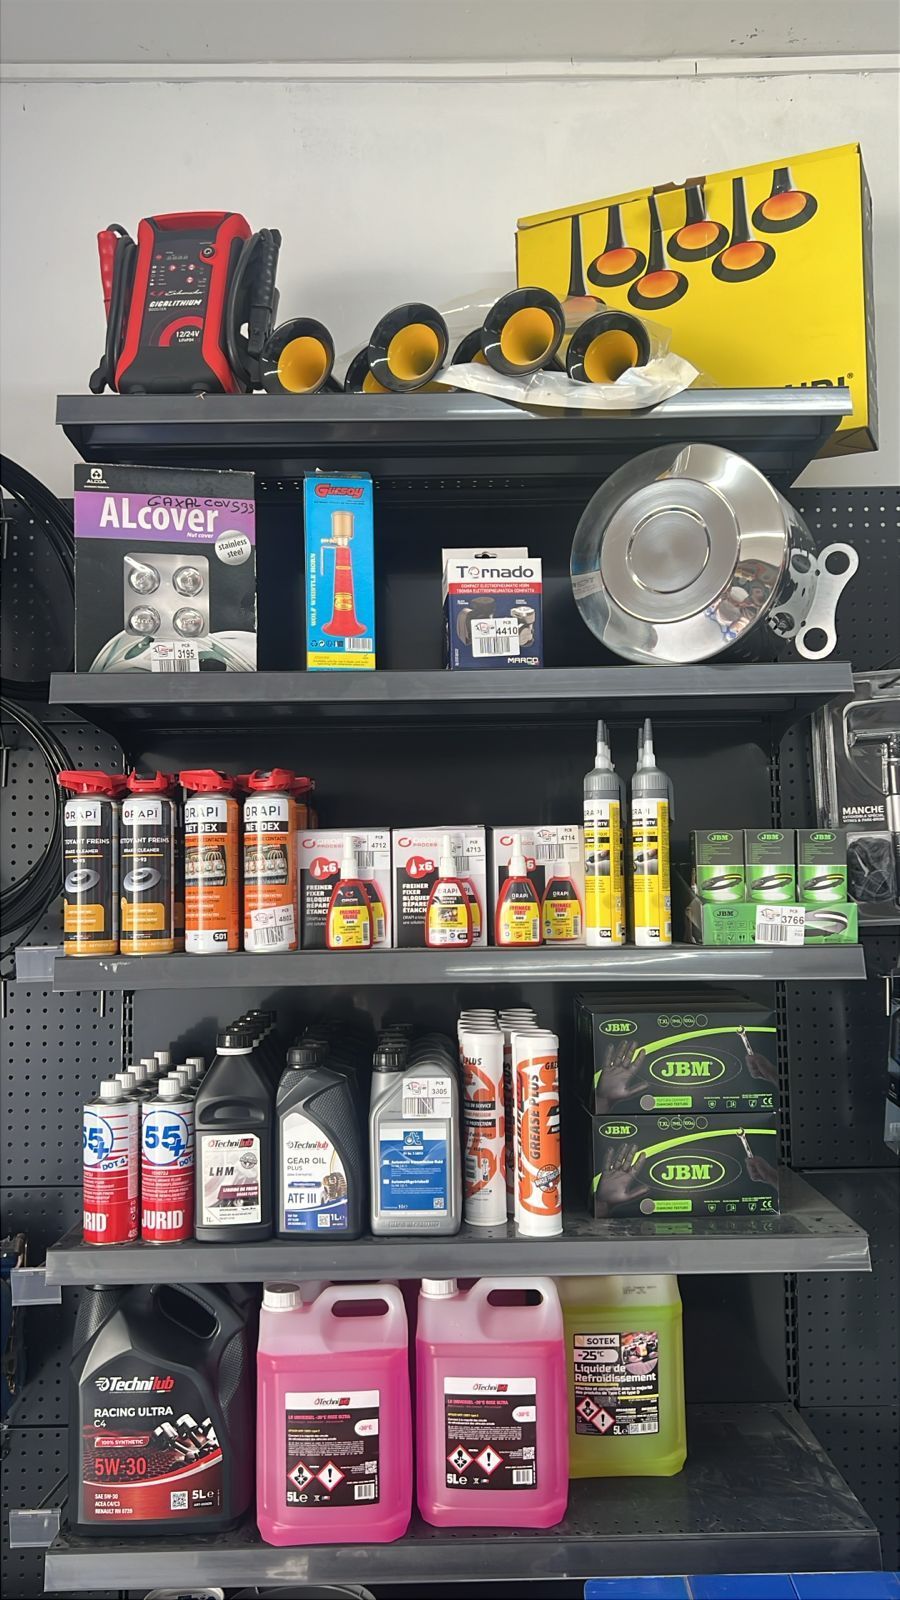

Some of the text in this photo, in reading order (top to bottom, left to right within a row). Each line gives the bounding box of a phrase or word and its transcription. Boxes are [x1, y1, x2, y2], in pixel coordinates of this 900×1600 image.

[176, 331, 201, 339] 12/24V
[99, 496, 219, 533] ALcover
[187, 531, 215, 540] Nut cover
[218, 538, 248, 551] stainless
[227, 548, 244, 559] steel
[456, 565, 534, 580] Tornado
[496, 626, 518, 636] 4410
[177, 649, 195, 659] 3195
[507, 657, 540, 665] MARCO
[842, 805, 885, 816] MANCHE
[418, 862, 435, 873] x6
[781, 915, 805, 925] 3766
[605, 1024, 631, 1032] JBM
[661, 1061, 712, 1078] JBM
[529, 1075, 541, 1160] GREASE PLUS
[604, 1126, 631, 1135] JBM
[214, 1138, 254, 1149] Technilub
[293, 1140, 329, 1150] Technilub
[102, 1161, 120, 1172] DOT
[286, 1157, 310, 1165] GEAR
[661, 1164, 712, 1181] JBM
[287, 1193, 317, 1204] ATF III
[142, 1210, 184, 1231] JURID
[586, 1337, 616, 1346] SOTEK
[578, 1350, 605, 1362] -25°C
[574, 1363, 627, 1375] Liquide de
[109, 1375, 176, 1392] Technilub
[574, 1372, 657, 1384] Refroidissement
[94, 1406, 174, 1419] RACING ULTRA
[94, 1420, 107, 1429] C4
[94, 1457, 148, 1476] 5W-30
[192, 1490, 207, 1500] 5L
